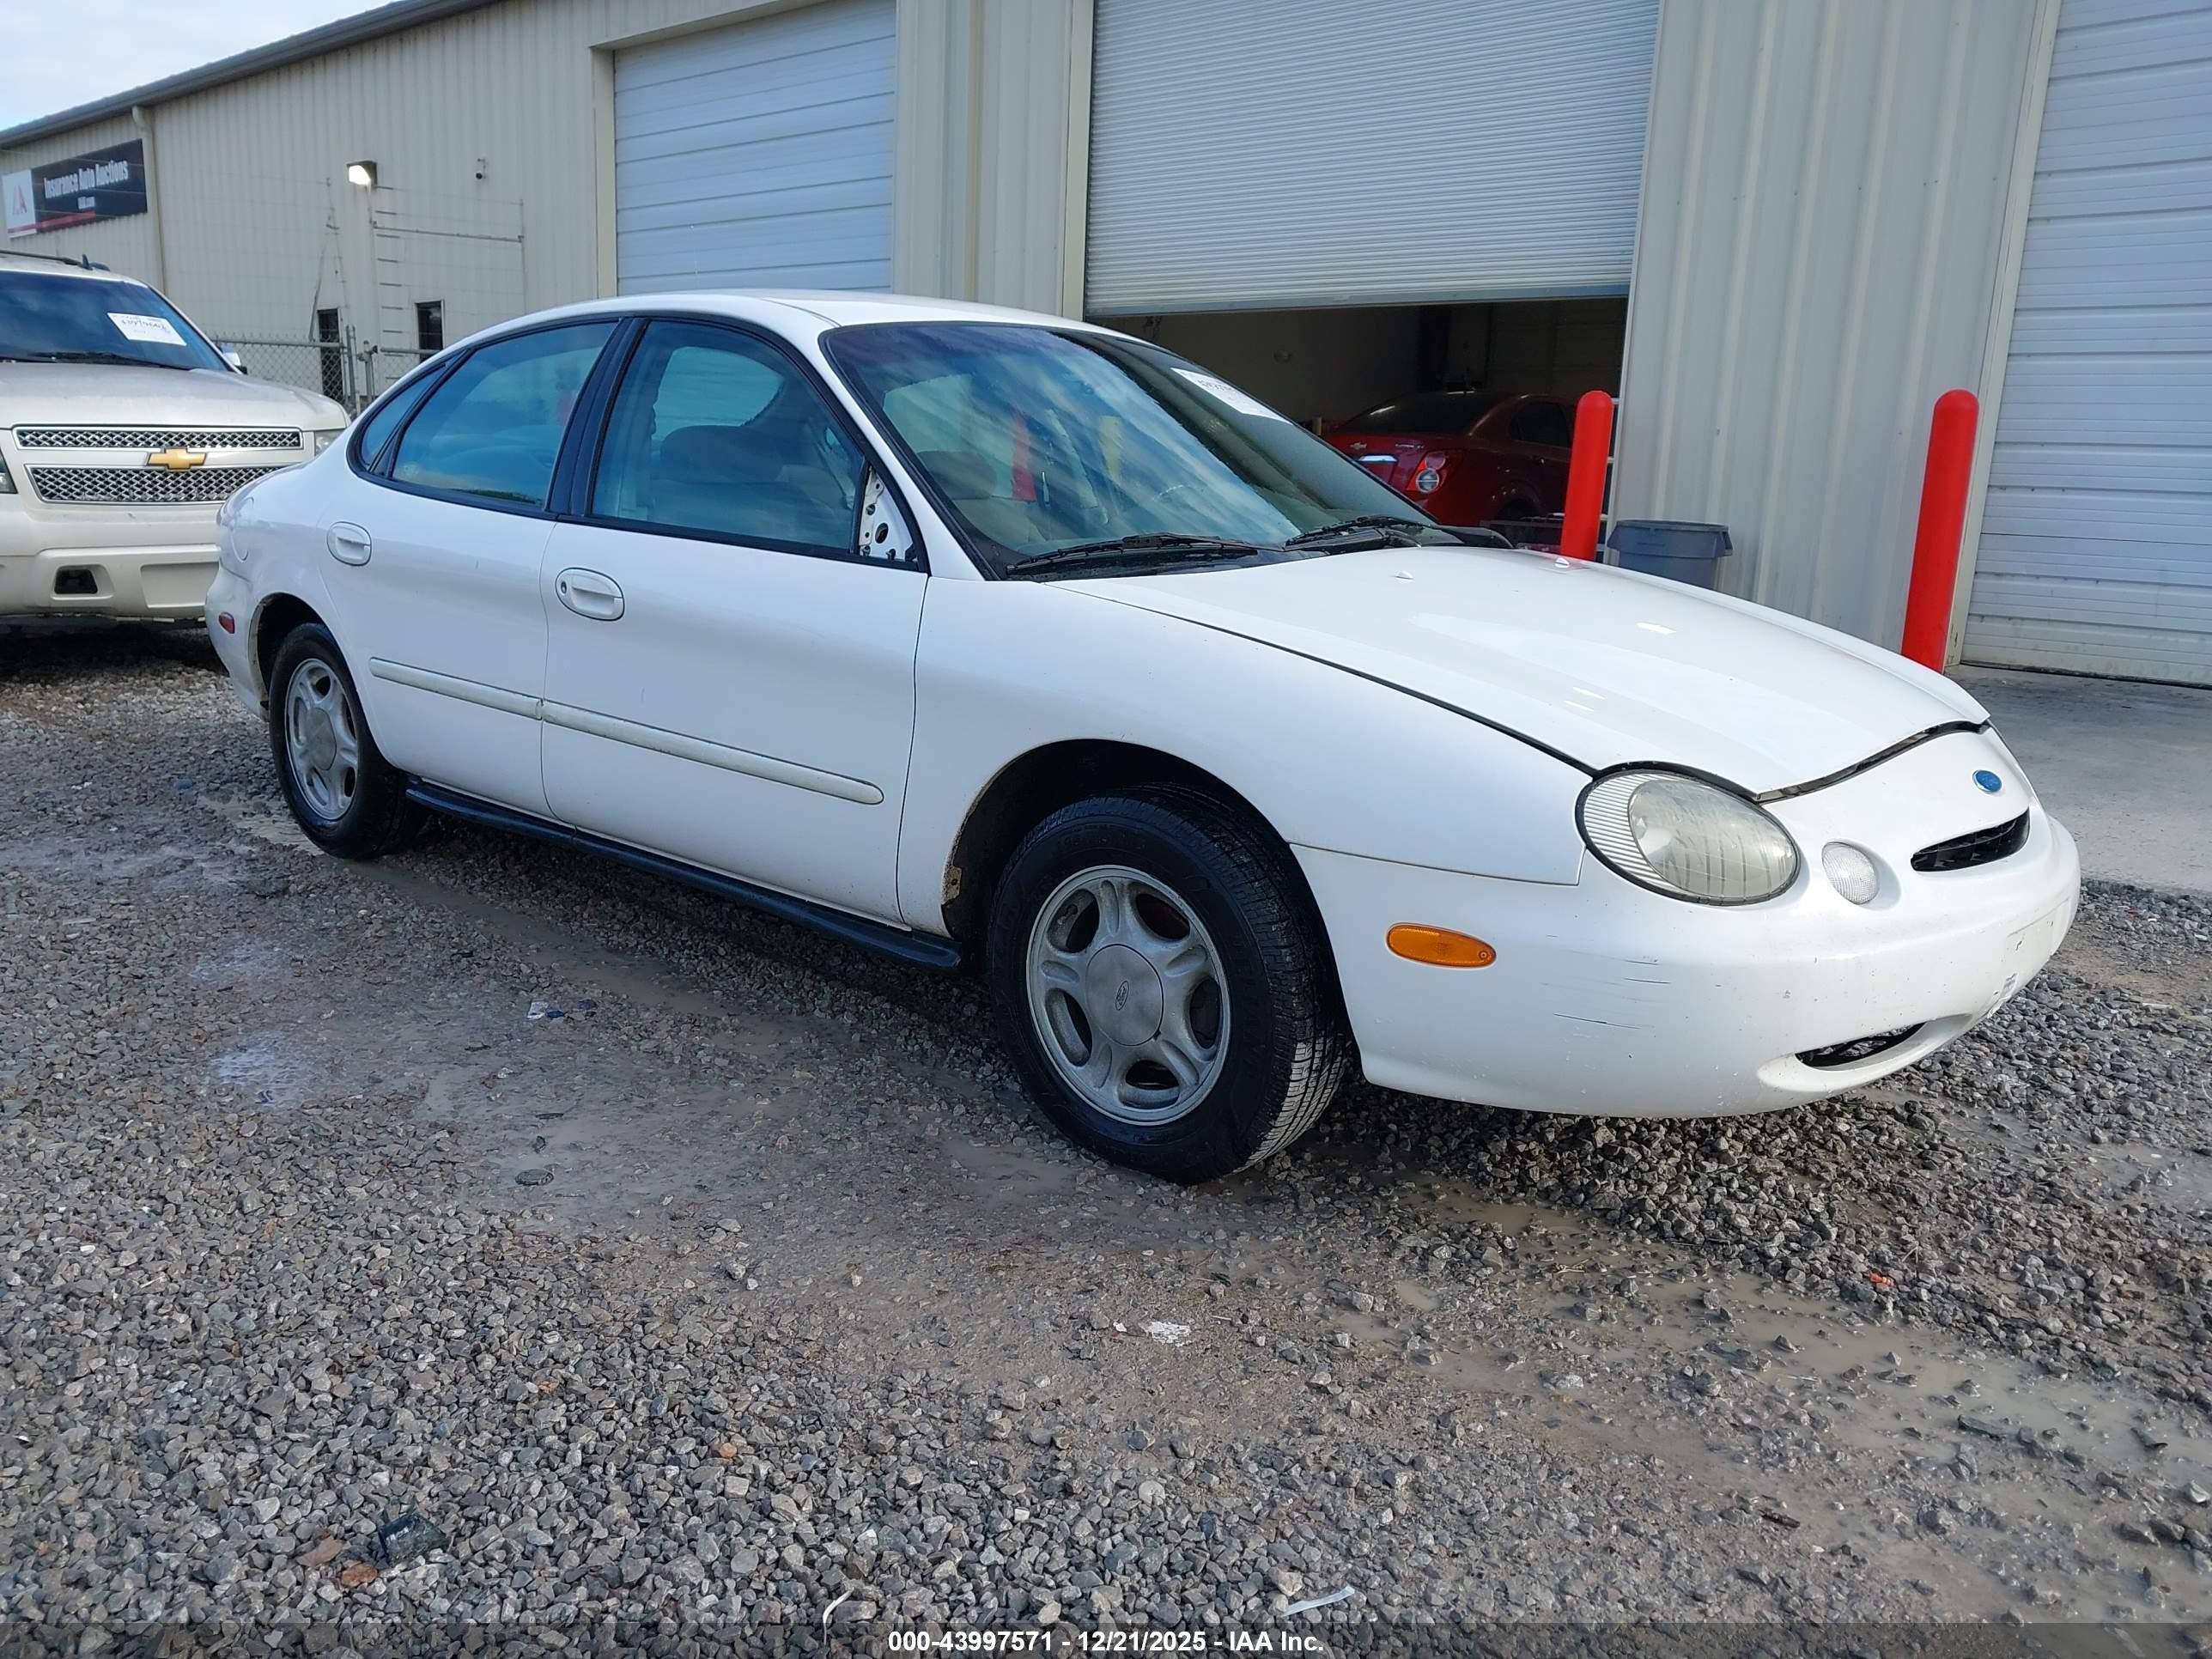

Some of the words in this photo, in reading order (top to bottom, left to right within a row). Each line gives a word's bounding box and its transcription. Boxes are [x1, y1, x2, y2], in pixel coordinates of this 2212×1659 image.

[44, 173, 78, 198] Insurance
[79, 168, 94, 190] Auto
[95, 160, 128, 185] Auctions
